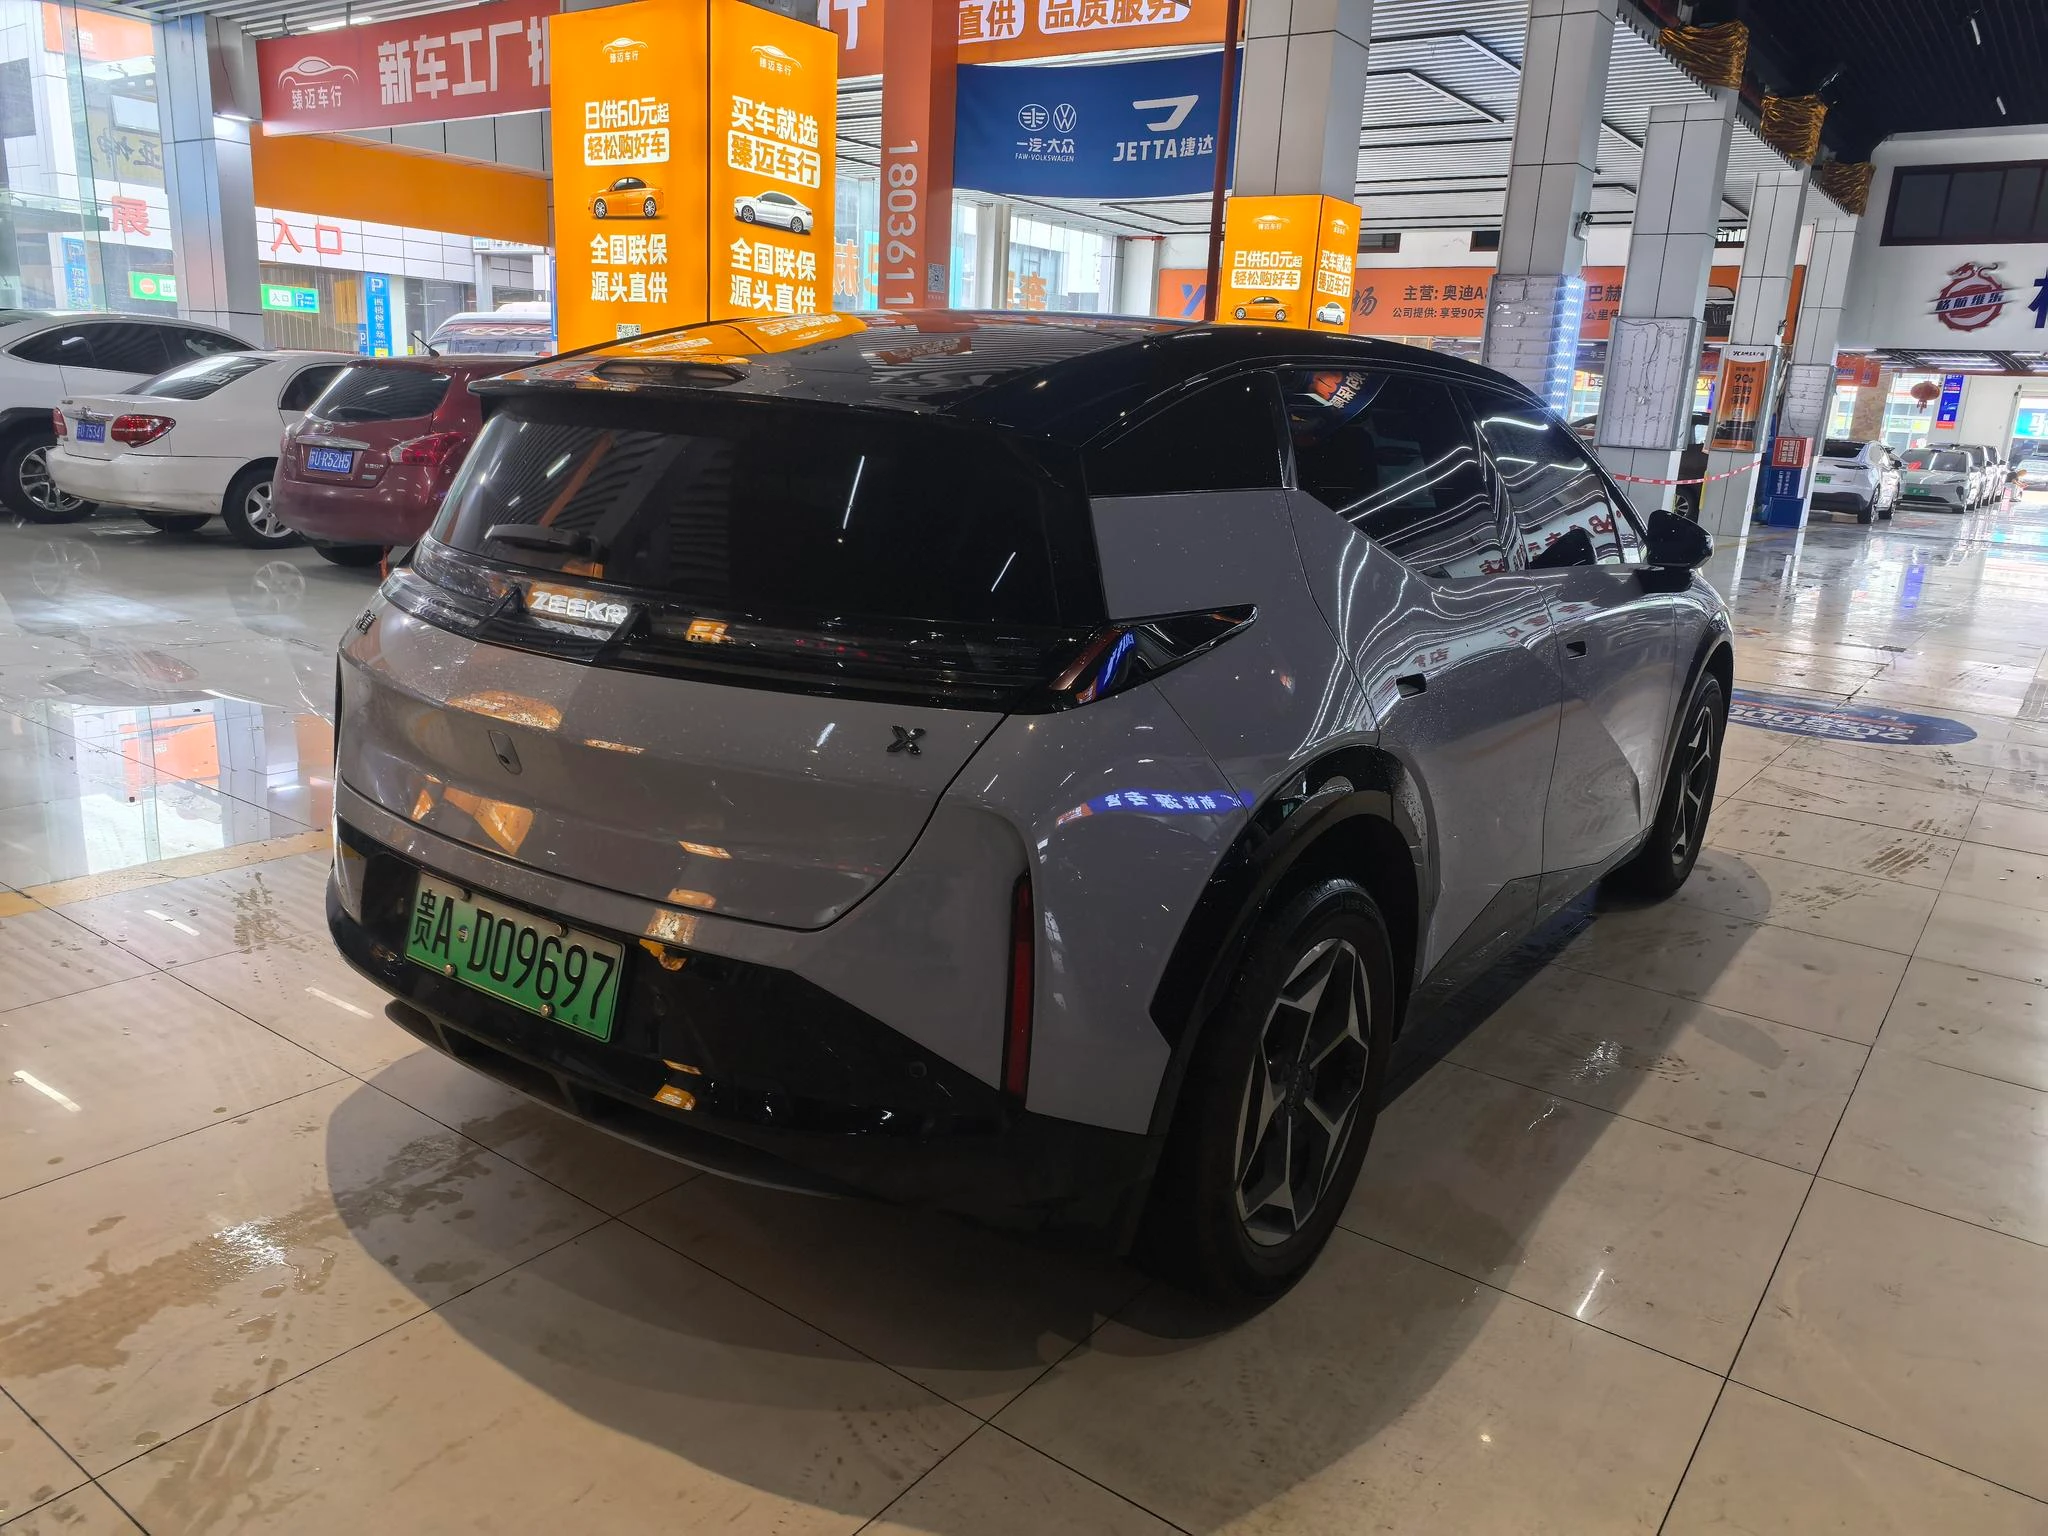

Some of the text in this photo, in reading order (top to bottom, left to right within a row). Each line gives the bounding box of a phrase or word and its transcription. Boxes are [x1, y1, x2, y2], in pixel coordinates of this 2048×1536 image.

[959, 0, 1016, 40] 直供
[291, 85, 342, 111] 臻迈车行
[731, 95, 819, 149] 买车就选
[587, 131, 666, 160] 轻松购好车
[731, 134, 818, 186] 臻迈车行
[111, 195, 151, 237] 展
[885, 140, 918, 304] 1803611
[271, 217, 342, 255] 入口
[590, 233, 668, 266] 全国联保
[730, 236, 817, 282] 全国联保
[1235, 270, 1298, 287] 轻松购好车
[590, 271, 668, 304] 源头直供
[729, 274, 817, 315] 源头直供
[530, 591, 628, 625] ZEEKR
